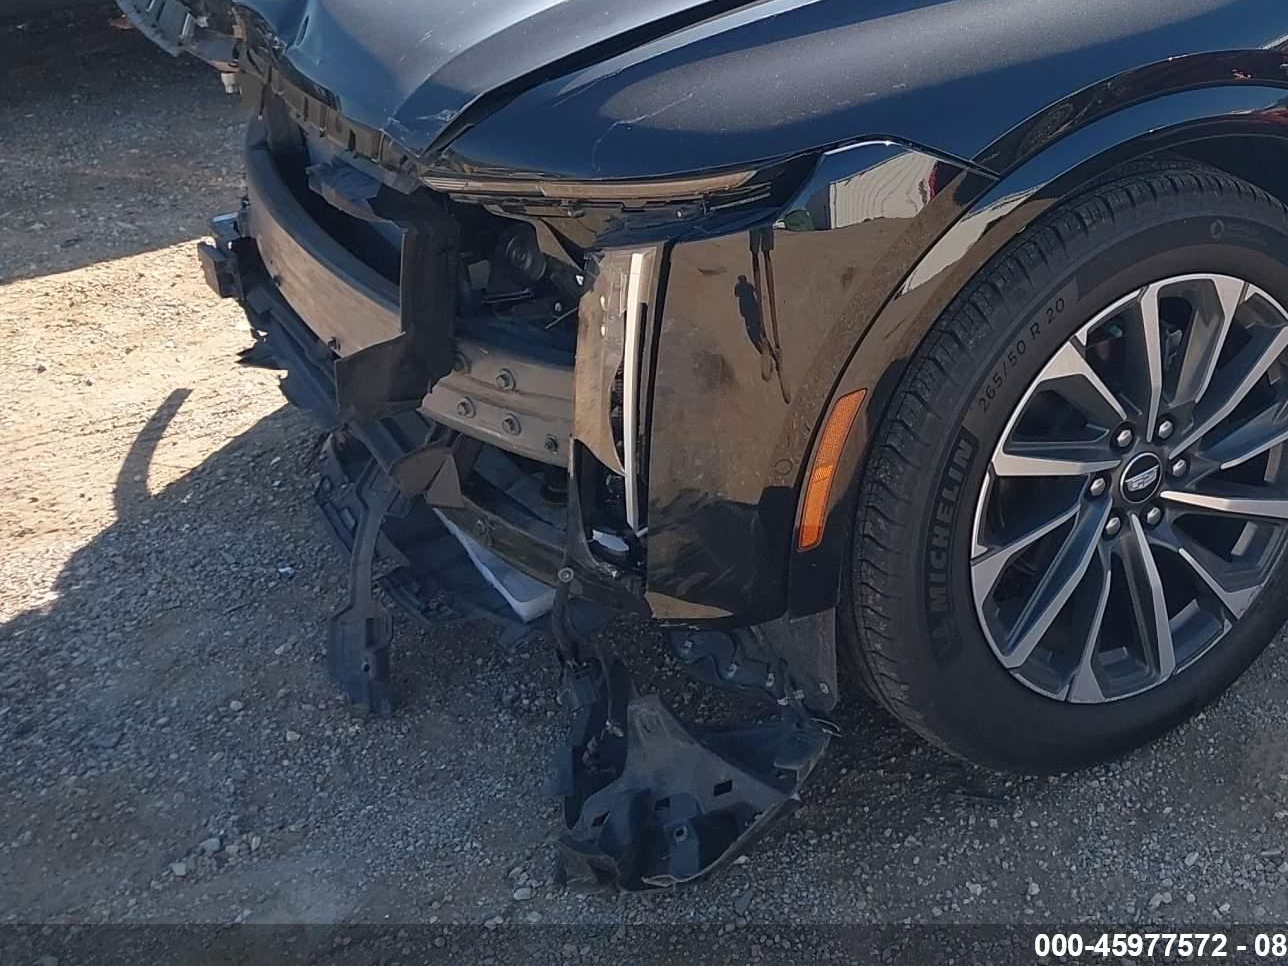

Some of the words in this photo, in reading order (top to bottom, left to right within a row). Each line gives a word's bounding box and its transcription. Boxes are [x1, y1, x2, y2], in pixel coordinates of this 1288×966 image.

[979, 339, 1026, 412] 265/50
[1029, 322, 1041, 340] R
[1045, 297, 1065, 324] 20
[928, 437, 973, 613] MICHELIN
